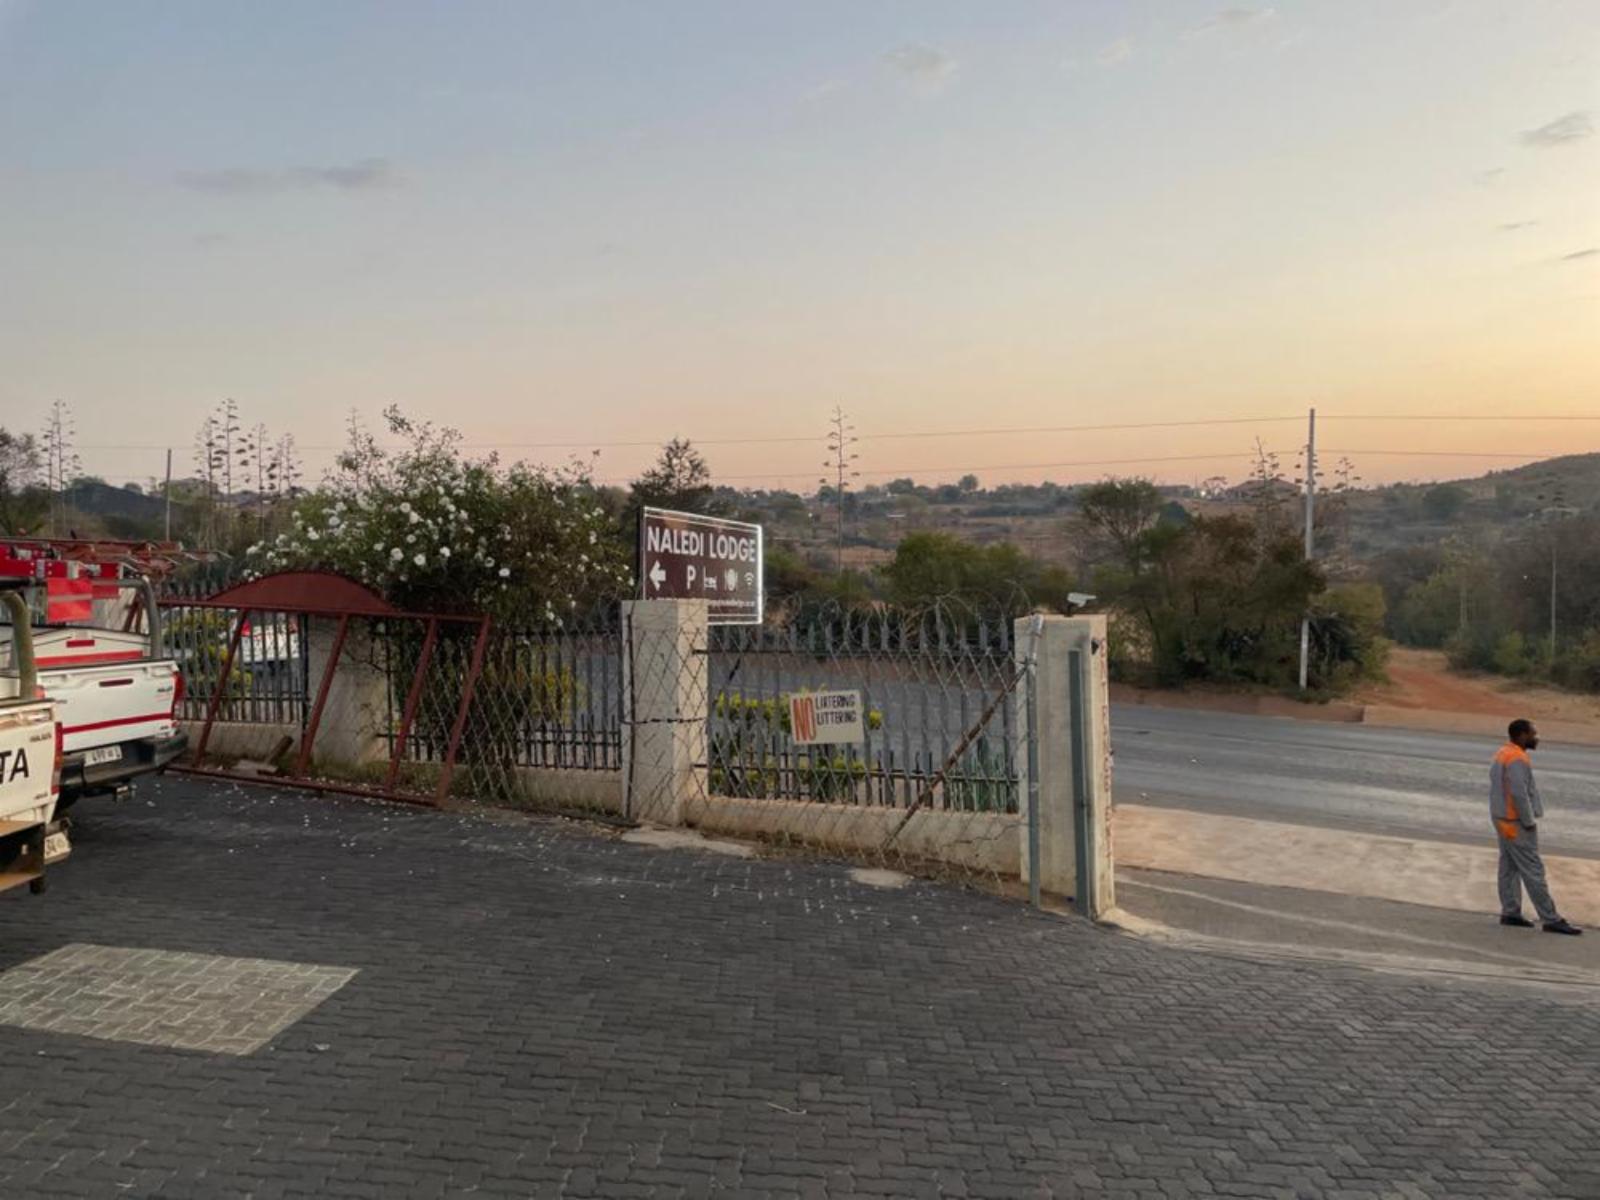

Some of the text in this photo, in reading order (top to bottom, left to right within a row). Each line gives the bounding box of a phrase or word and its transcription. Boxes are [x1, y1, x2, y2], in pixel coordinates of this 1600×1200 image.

[647, 526, 756, 562] NALEDI LODGE
[686, 564, 697, 590] P
[793, 696, 817, 741] NO
